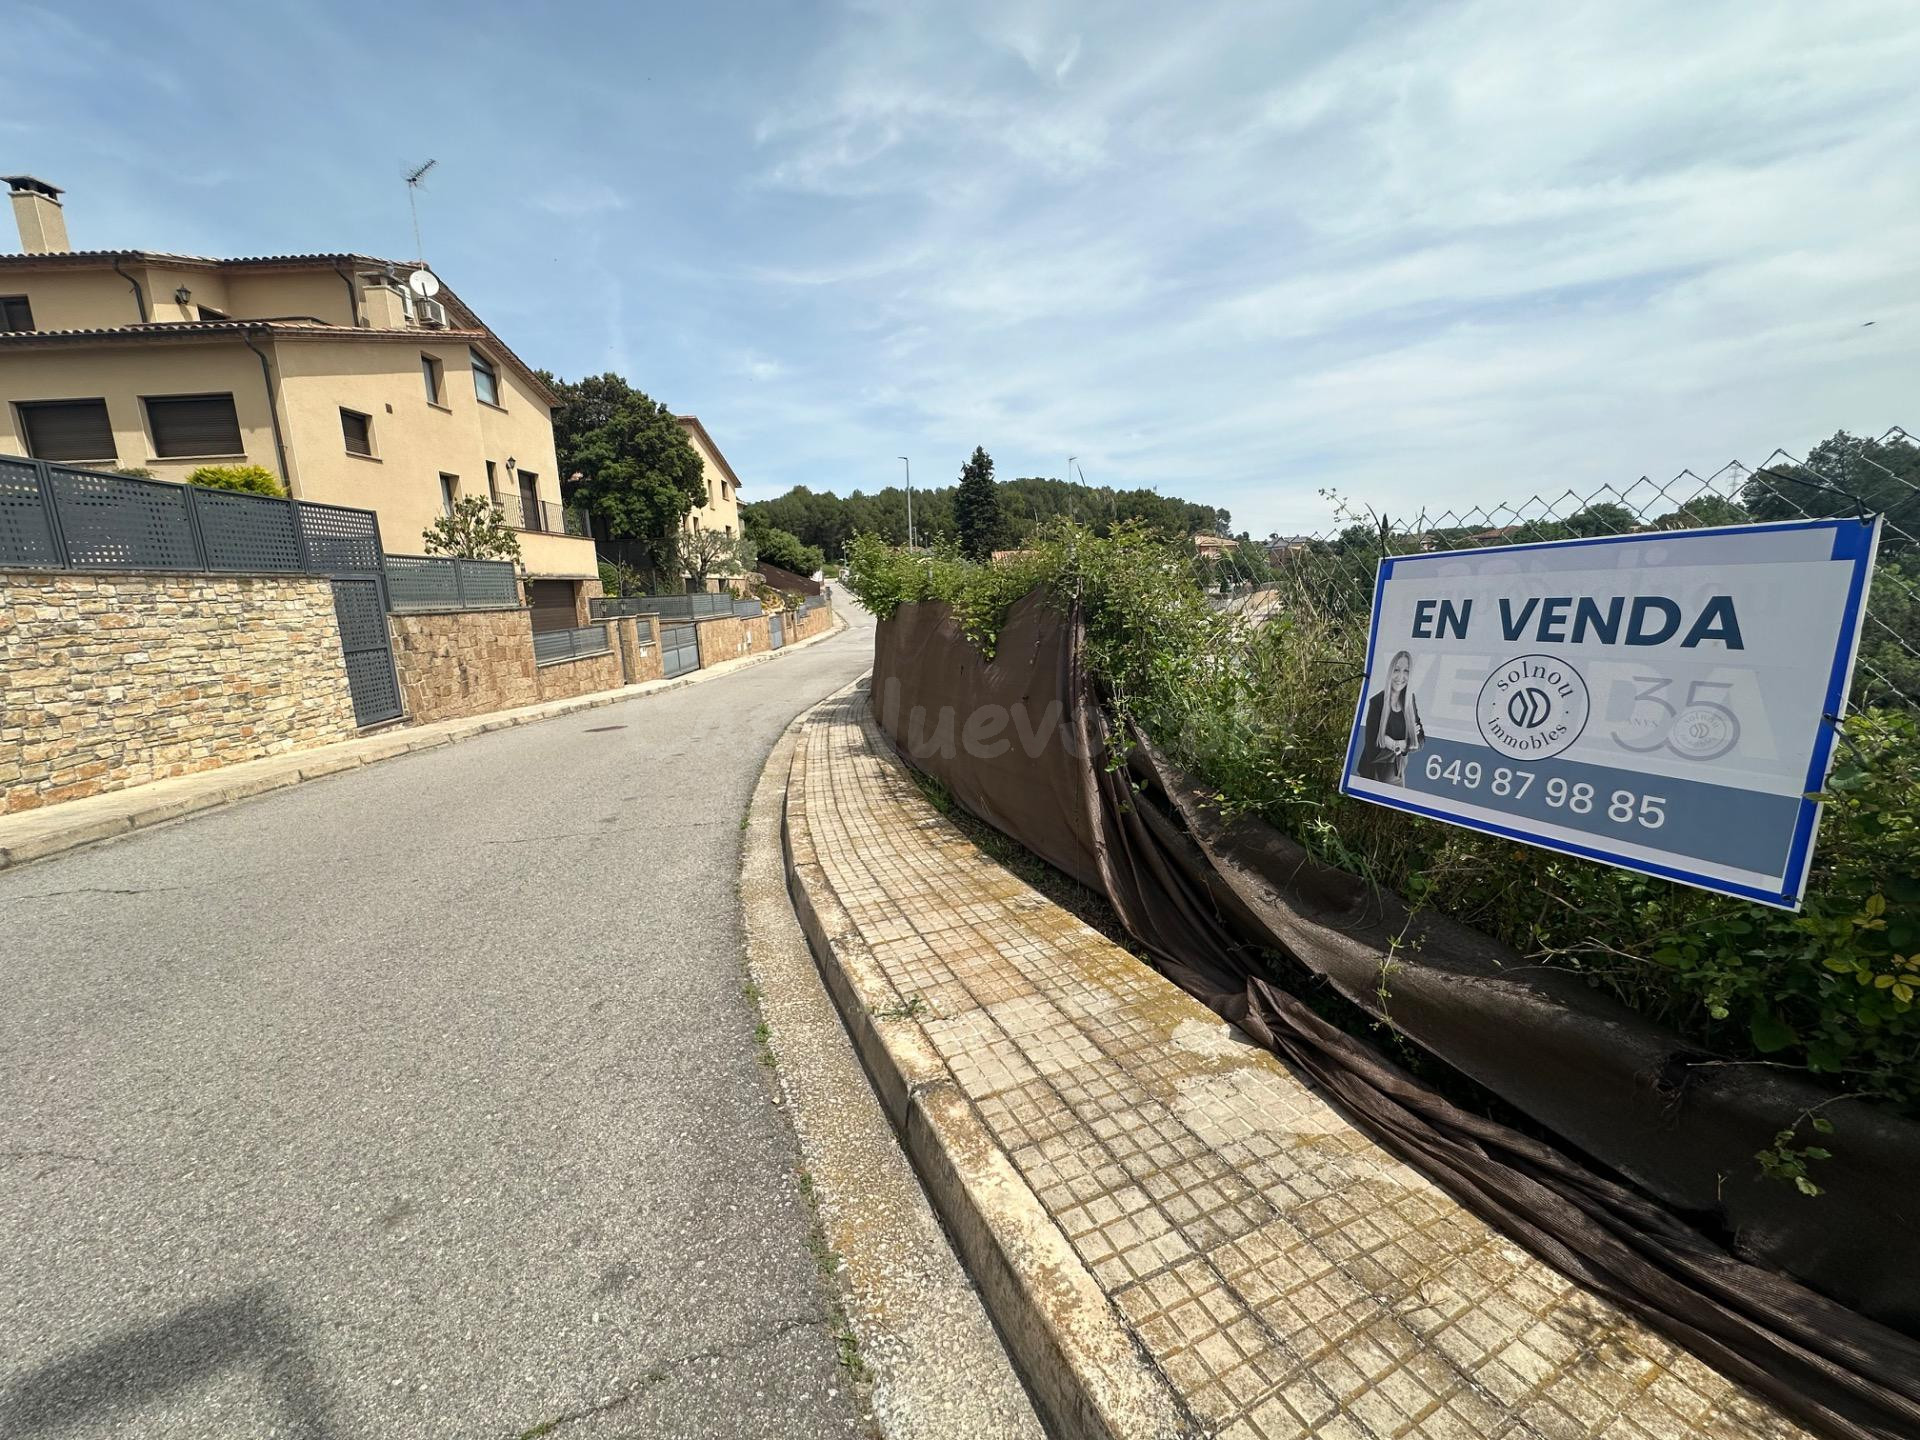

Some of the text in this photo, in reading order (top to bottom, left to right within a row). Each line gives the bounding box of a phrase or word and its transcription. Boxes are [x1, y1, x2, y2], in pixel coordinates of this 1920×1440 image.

[1411, 595, 1745, 651] EN VENDA
[1497, 660, 1574, 699] solnou
[1488, 716, 1568, 751] immobles
[1425, 754, 1668, 829] 649 87 98 85
